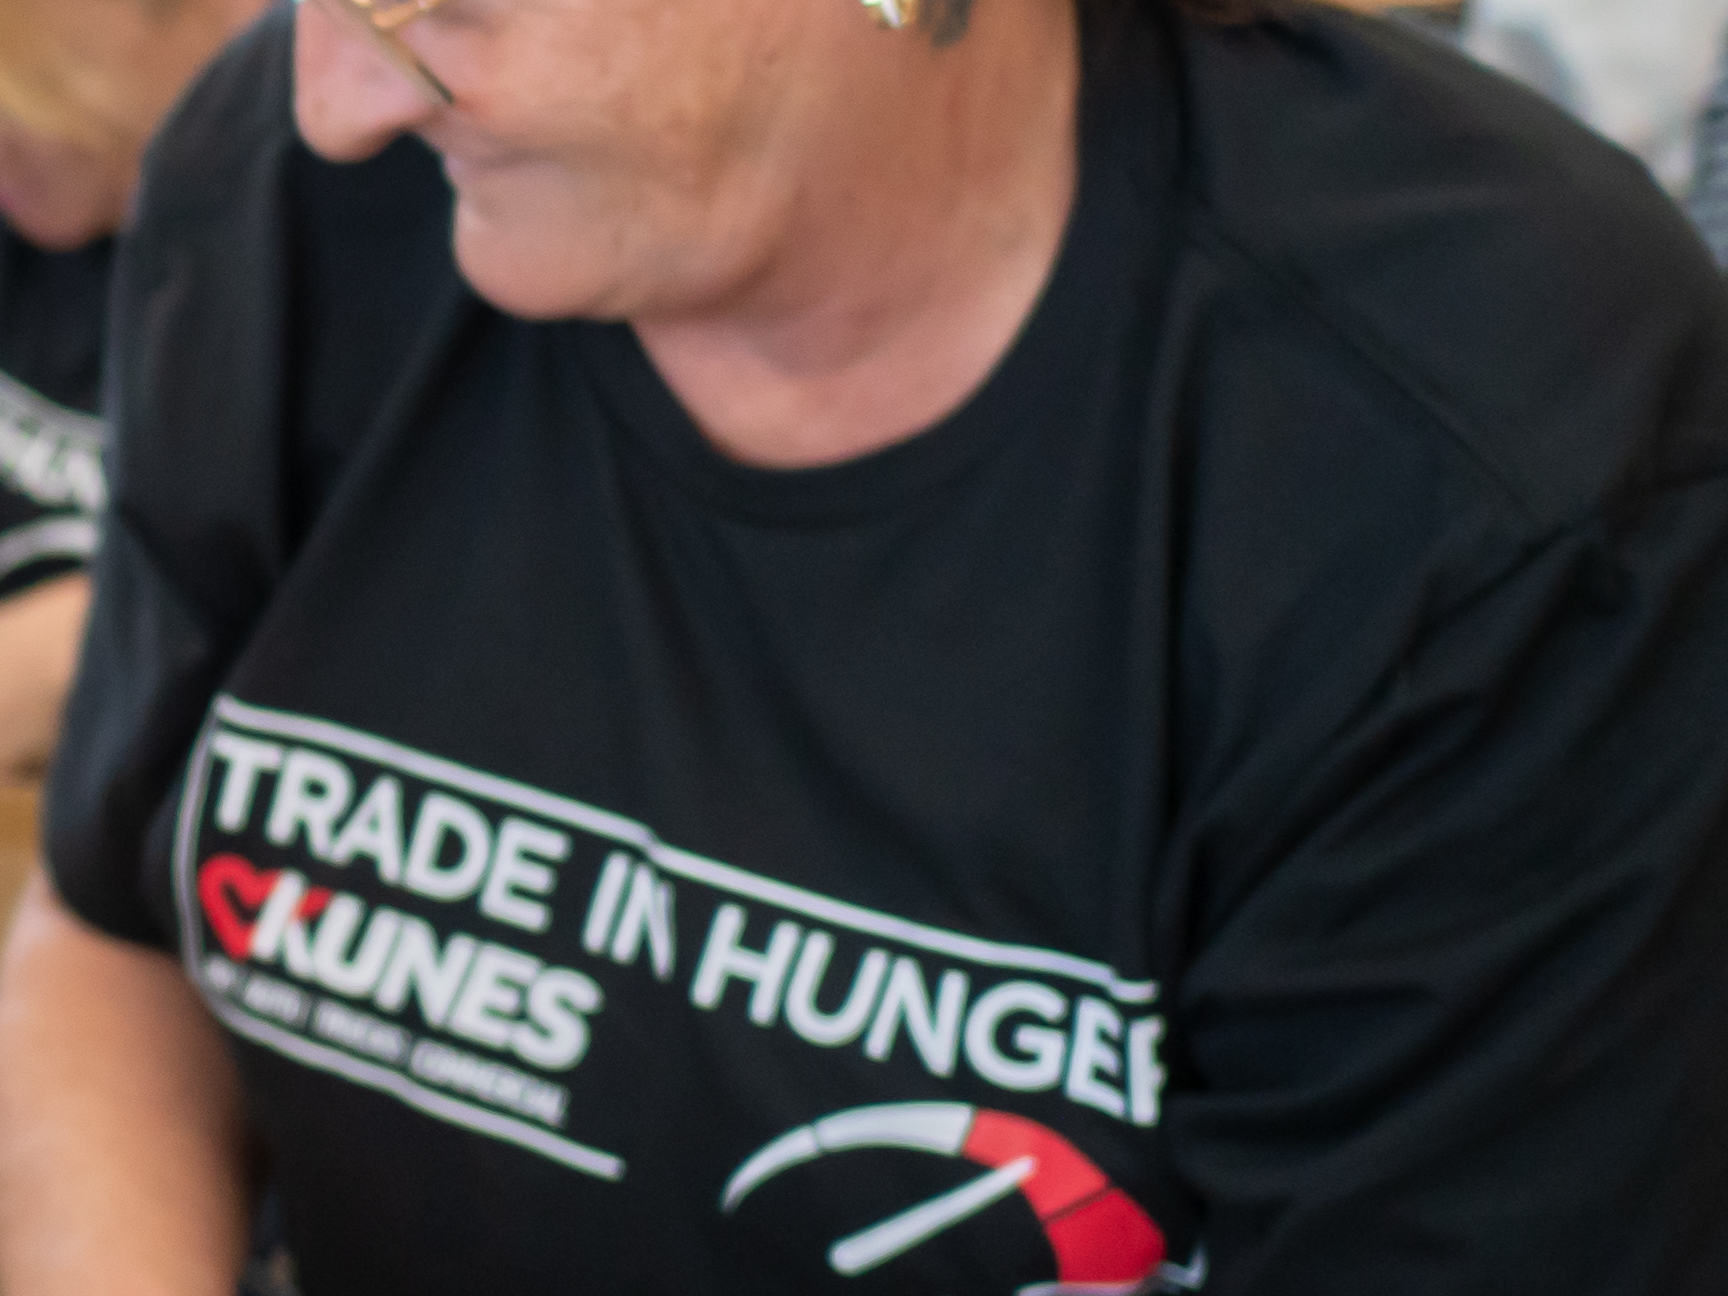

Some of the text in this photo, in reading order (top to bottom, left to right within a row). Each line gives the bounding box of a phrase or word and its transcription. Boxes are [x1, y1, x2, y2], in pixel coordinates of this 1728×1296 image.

[208, 726, 572, 934] TRADE
[582, 850, 678, 982] IN
[244, 869, 604, 1071] KUNES
